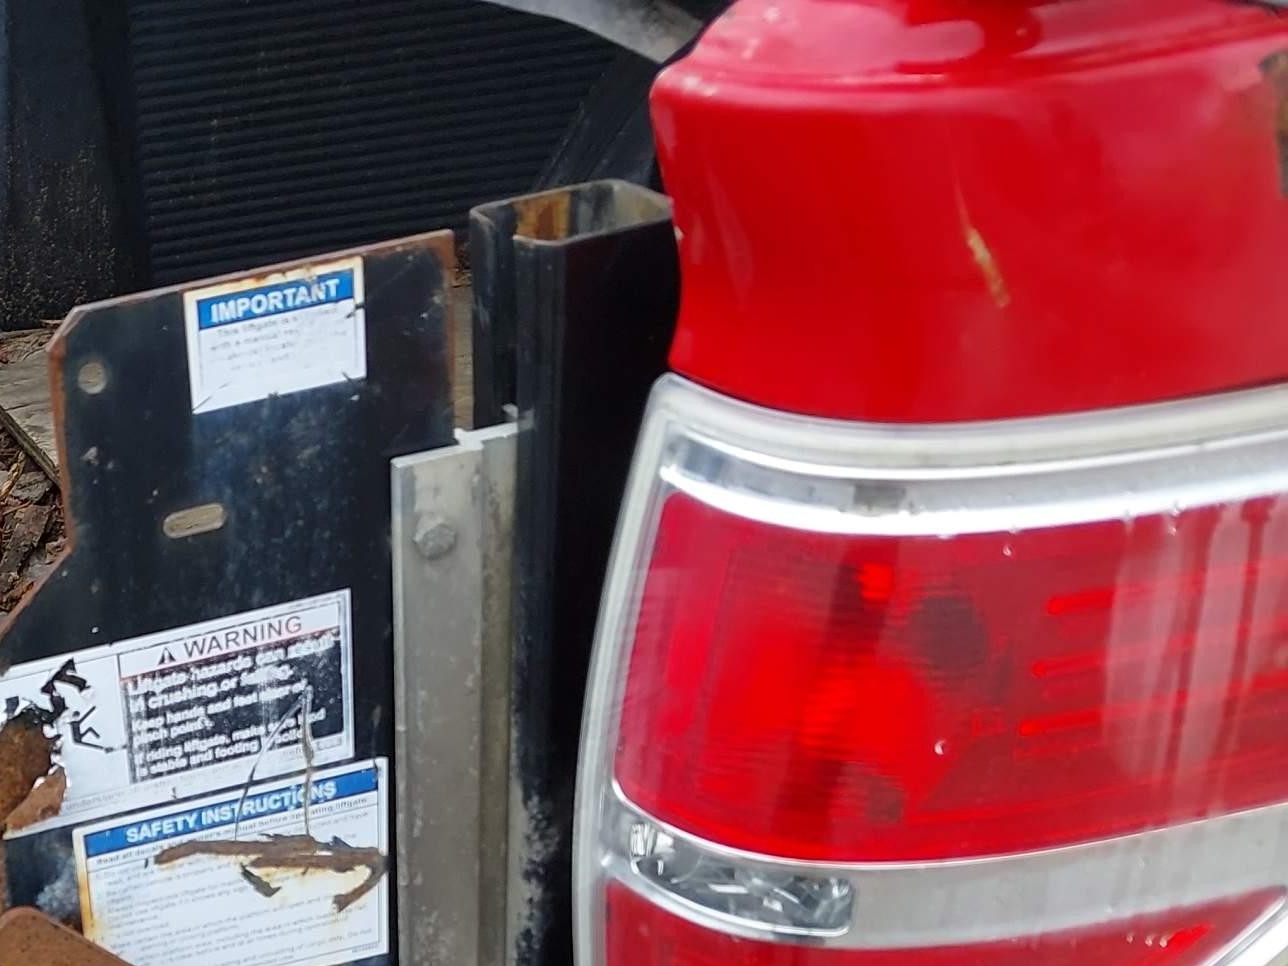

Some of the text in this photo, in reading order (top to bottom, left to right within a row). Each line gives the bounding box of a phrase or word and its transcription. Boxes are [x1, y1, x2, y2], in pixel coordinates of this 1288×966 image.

[211, 278, 340, 324] IMPORTANT
[184, 614, 301, 659] WARNING
[191, 653, 251, 681] hazards
[256, 647, 284, 665] can
[148, 680, 217, 709] crushing
[221, 677, 237, 691] or
[146, 743, 181, 762] riding
[151, 755, 186, 775] stable
[190, 749, 211, 765] and
[214, 738, 258, 760] footing
[126, 813, 197, 843] SAFETY
[201, 781, 337, 826] INSTRUCTIONS
